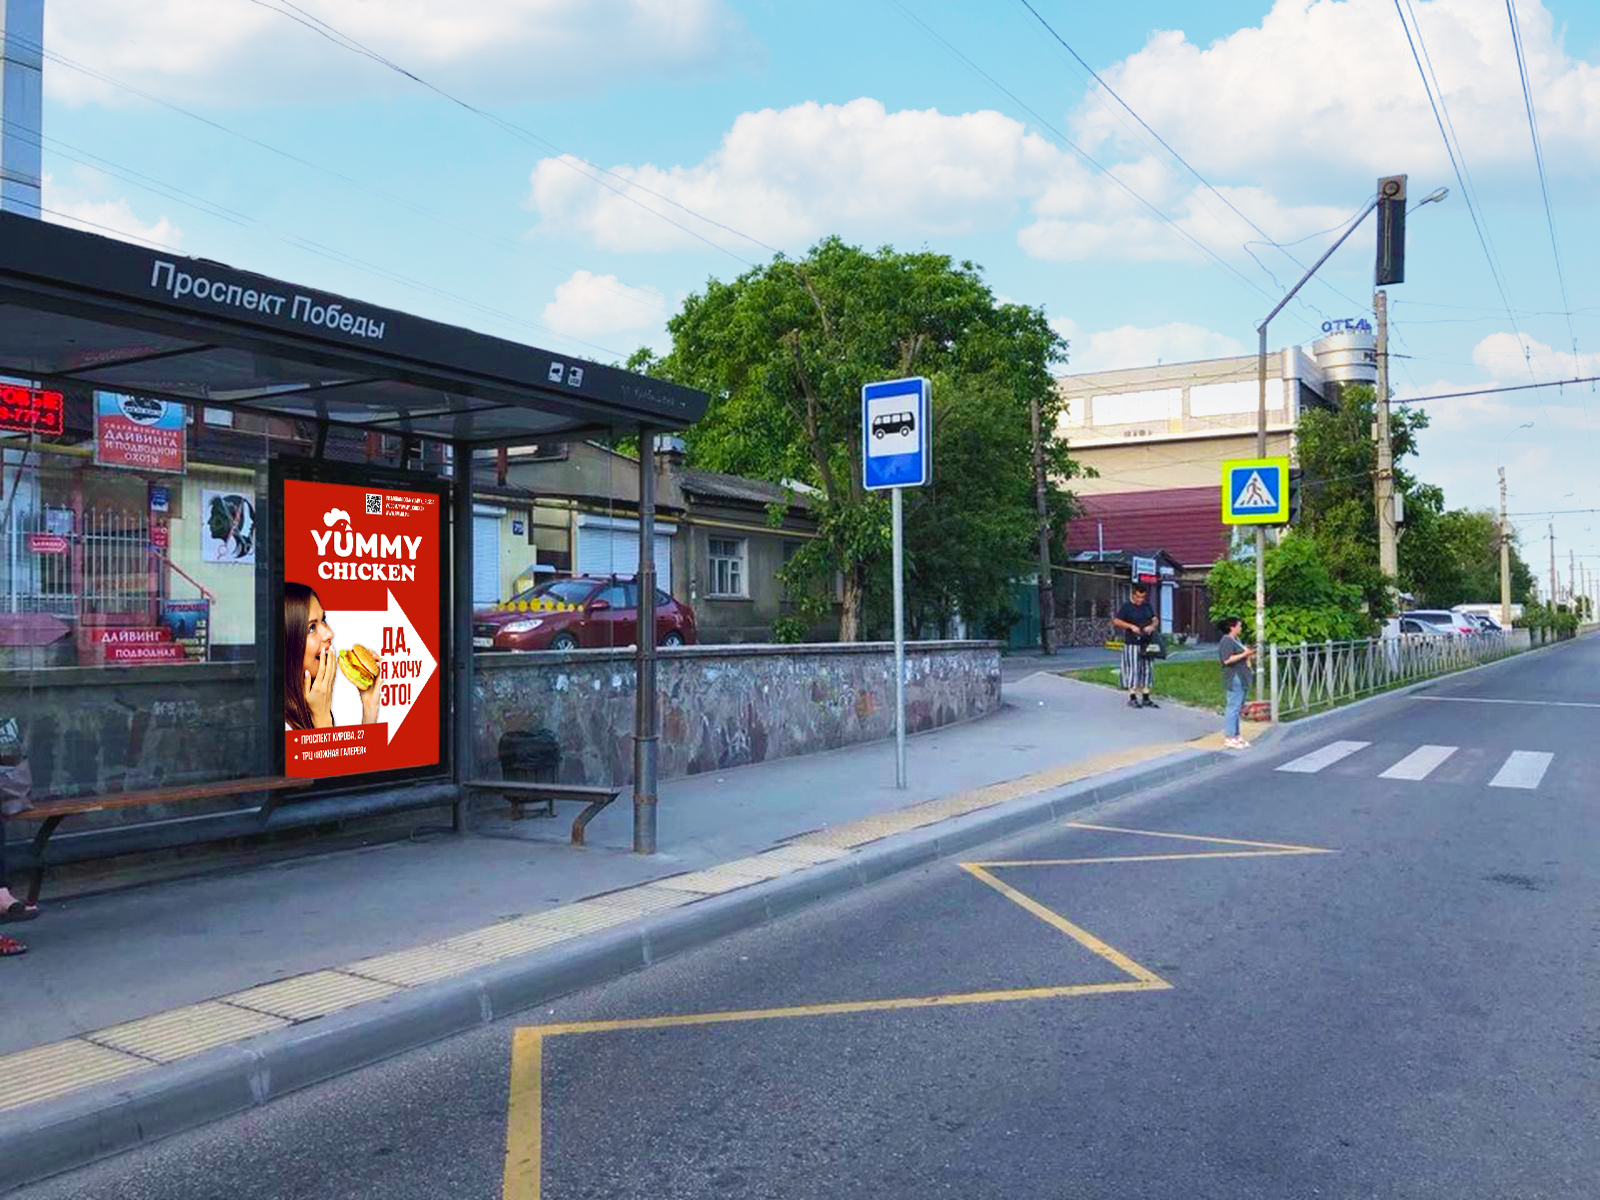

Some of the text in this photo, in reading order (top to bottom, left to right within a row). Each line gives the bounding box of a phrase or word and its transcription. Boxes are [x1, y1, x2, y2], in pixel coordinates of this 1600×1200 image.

[150, 260, 385, 339] Проспект Победы
[1321, 318, 1372, 333] ОТЕЛЬ
[104, 429, 177, 448] ДАЙВИНГА
[125, 452, 159, 464] ОХОТЫ
[310, 529, 422, 560] YUMMY
[317, 561, 416, 582] CHICKEN
[101, 630, 162, 642] ДАЙВИНГ
[381, 626, 411, 656] ДА,
[115, 648, 176, 658] ПОДВОДНАЯ
[381, 660, 422, 679] Я ХОЧУ
[381, 683, 411, 706] ЭТО!
[301, 732, 331, 745] ПРОСПЕКТ
[357, 729, 365, 740] 27
[302, 751, 313, 760] ТРЦ
